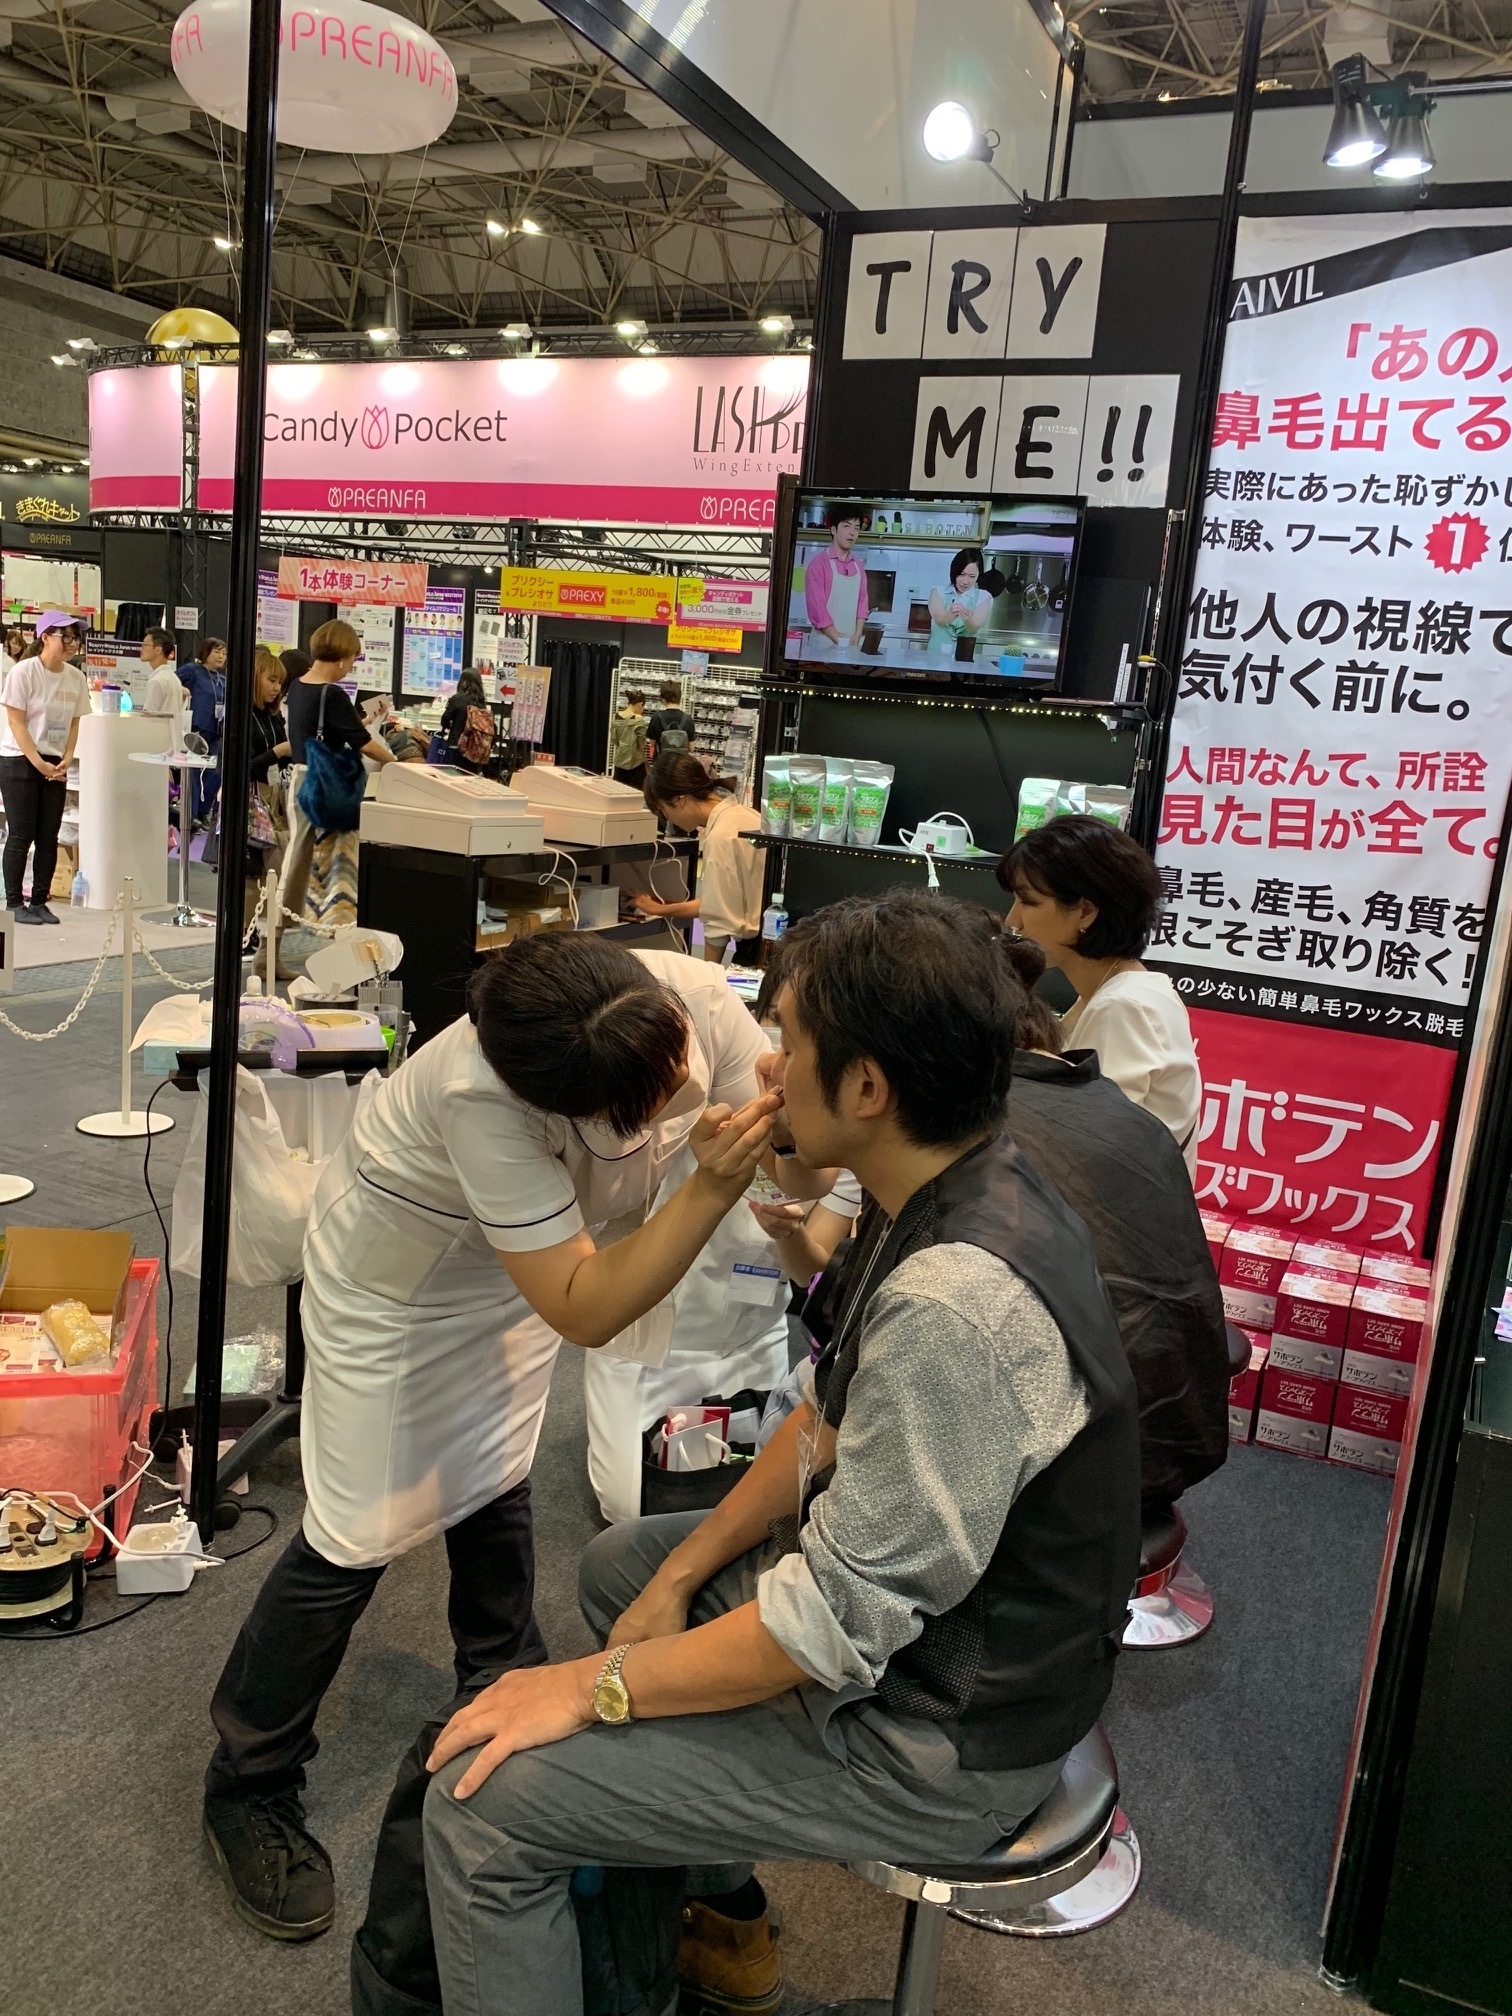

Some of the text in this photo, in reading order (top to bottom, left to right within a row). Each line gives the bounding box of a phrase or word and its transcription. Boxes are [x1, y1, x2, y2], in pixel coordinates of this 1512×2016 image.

[291, 11, 454, 101] PREANFA
[866, 256, 1083, 335] TRY
[1230, 265, 1323, 318] AIVIL
[1346, 322, 1512, 383] 「あの
[263, 410, 507, 447] Candy Pocket
[924, 404, 1153, 483] ME!!
[343, 488, 427, 510] PREANFA
[36, 533, 72, 545] PREANFA
[904, 521, 974, 536] SABOTEN
[300, 567, 406, 592] 1本体験コーナー
[569, 588, 605, 603] PREXY
[1181, 649, 1470, 721] 気付く前に。
[1166, 746, 1489, 793] 人間なんて、所詮
[1157, 794, 1500, 860] 見た目が全て。
[1170, 977, 1465, 1038] の少ない簡単鼻毛ワックス脱毛
